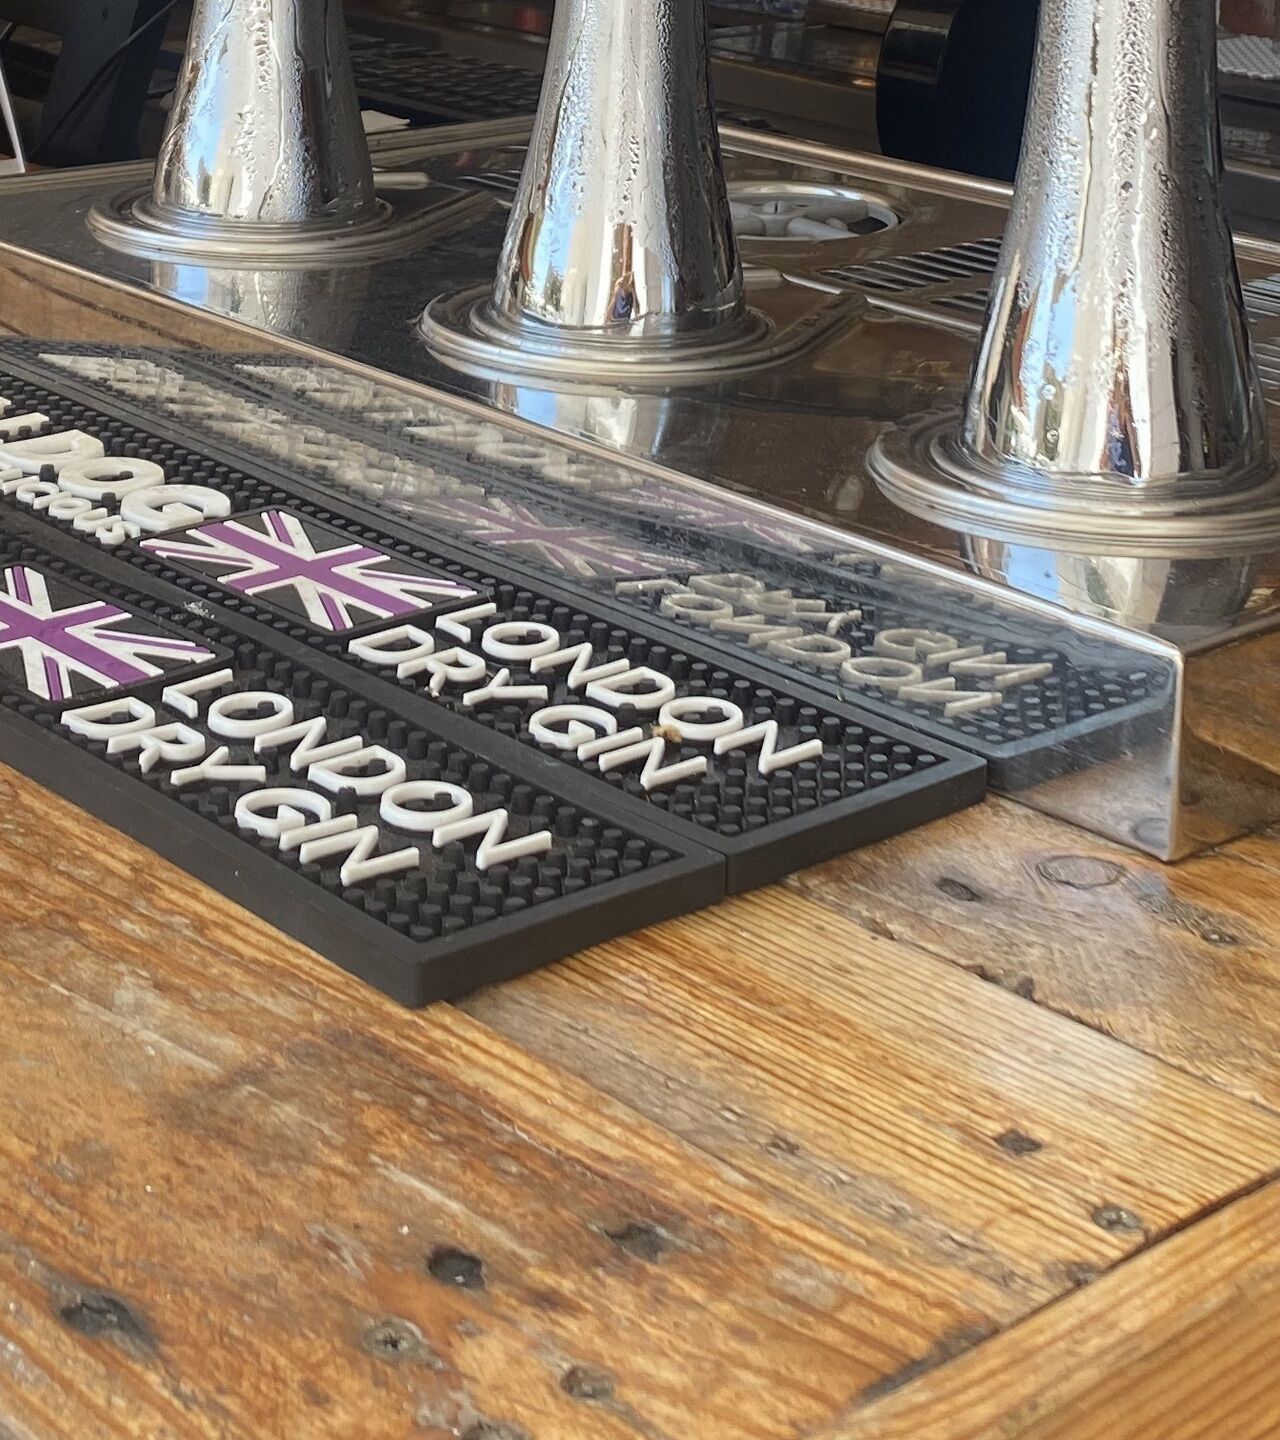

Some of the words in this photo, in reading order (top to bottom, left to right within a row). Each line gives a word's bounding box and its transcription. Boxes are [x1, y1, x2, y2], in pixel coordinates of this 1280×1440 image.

[161, 668, 553, 871] LONDON
[349, 624, 549, 707] DRY
[529, 704, 708, 790] GIN
[437, 602, 822, 774] LONDON
[61, 696, 266, 787] DRY
[235, 787, 419, 887] GIN
